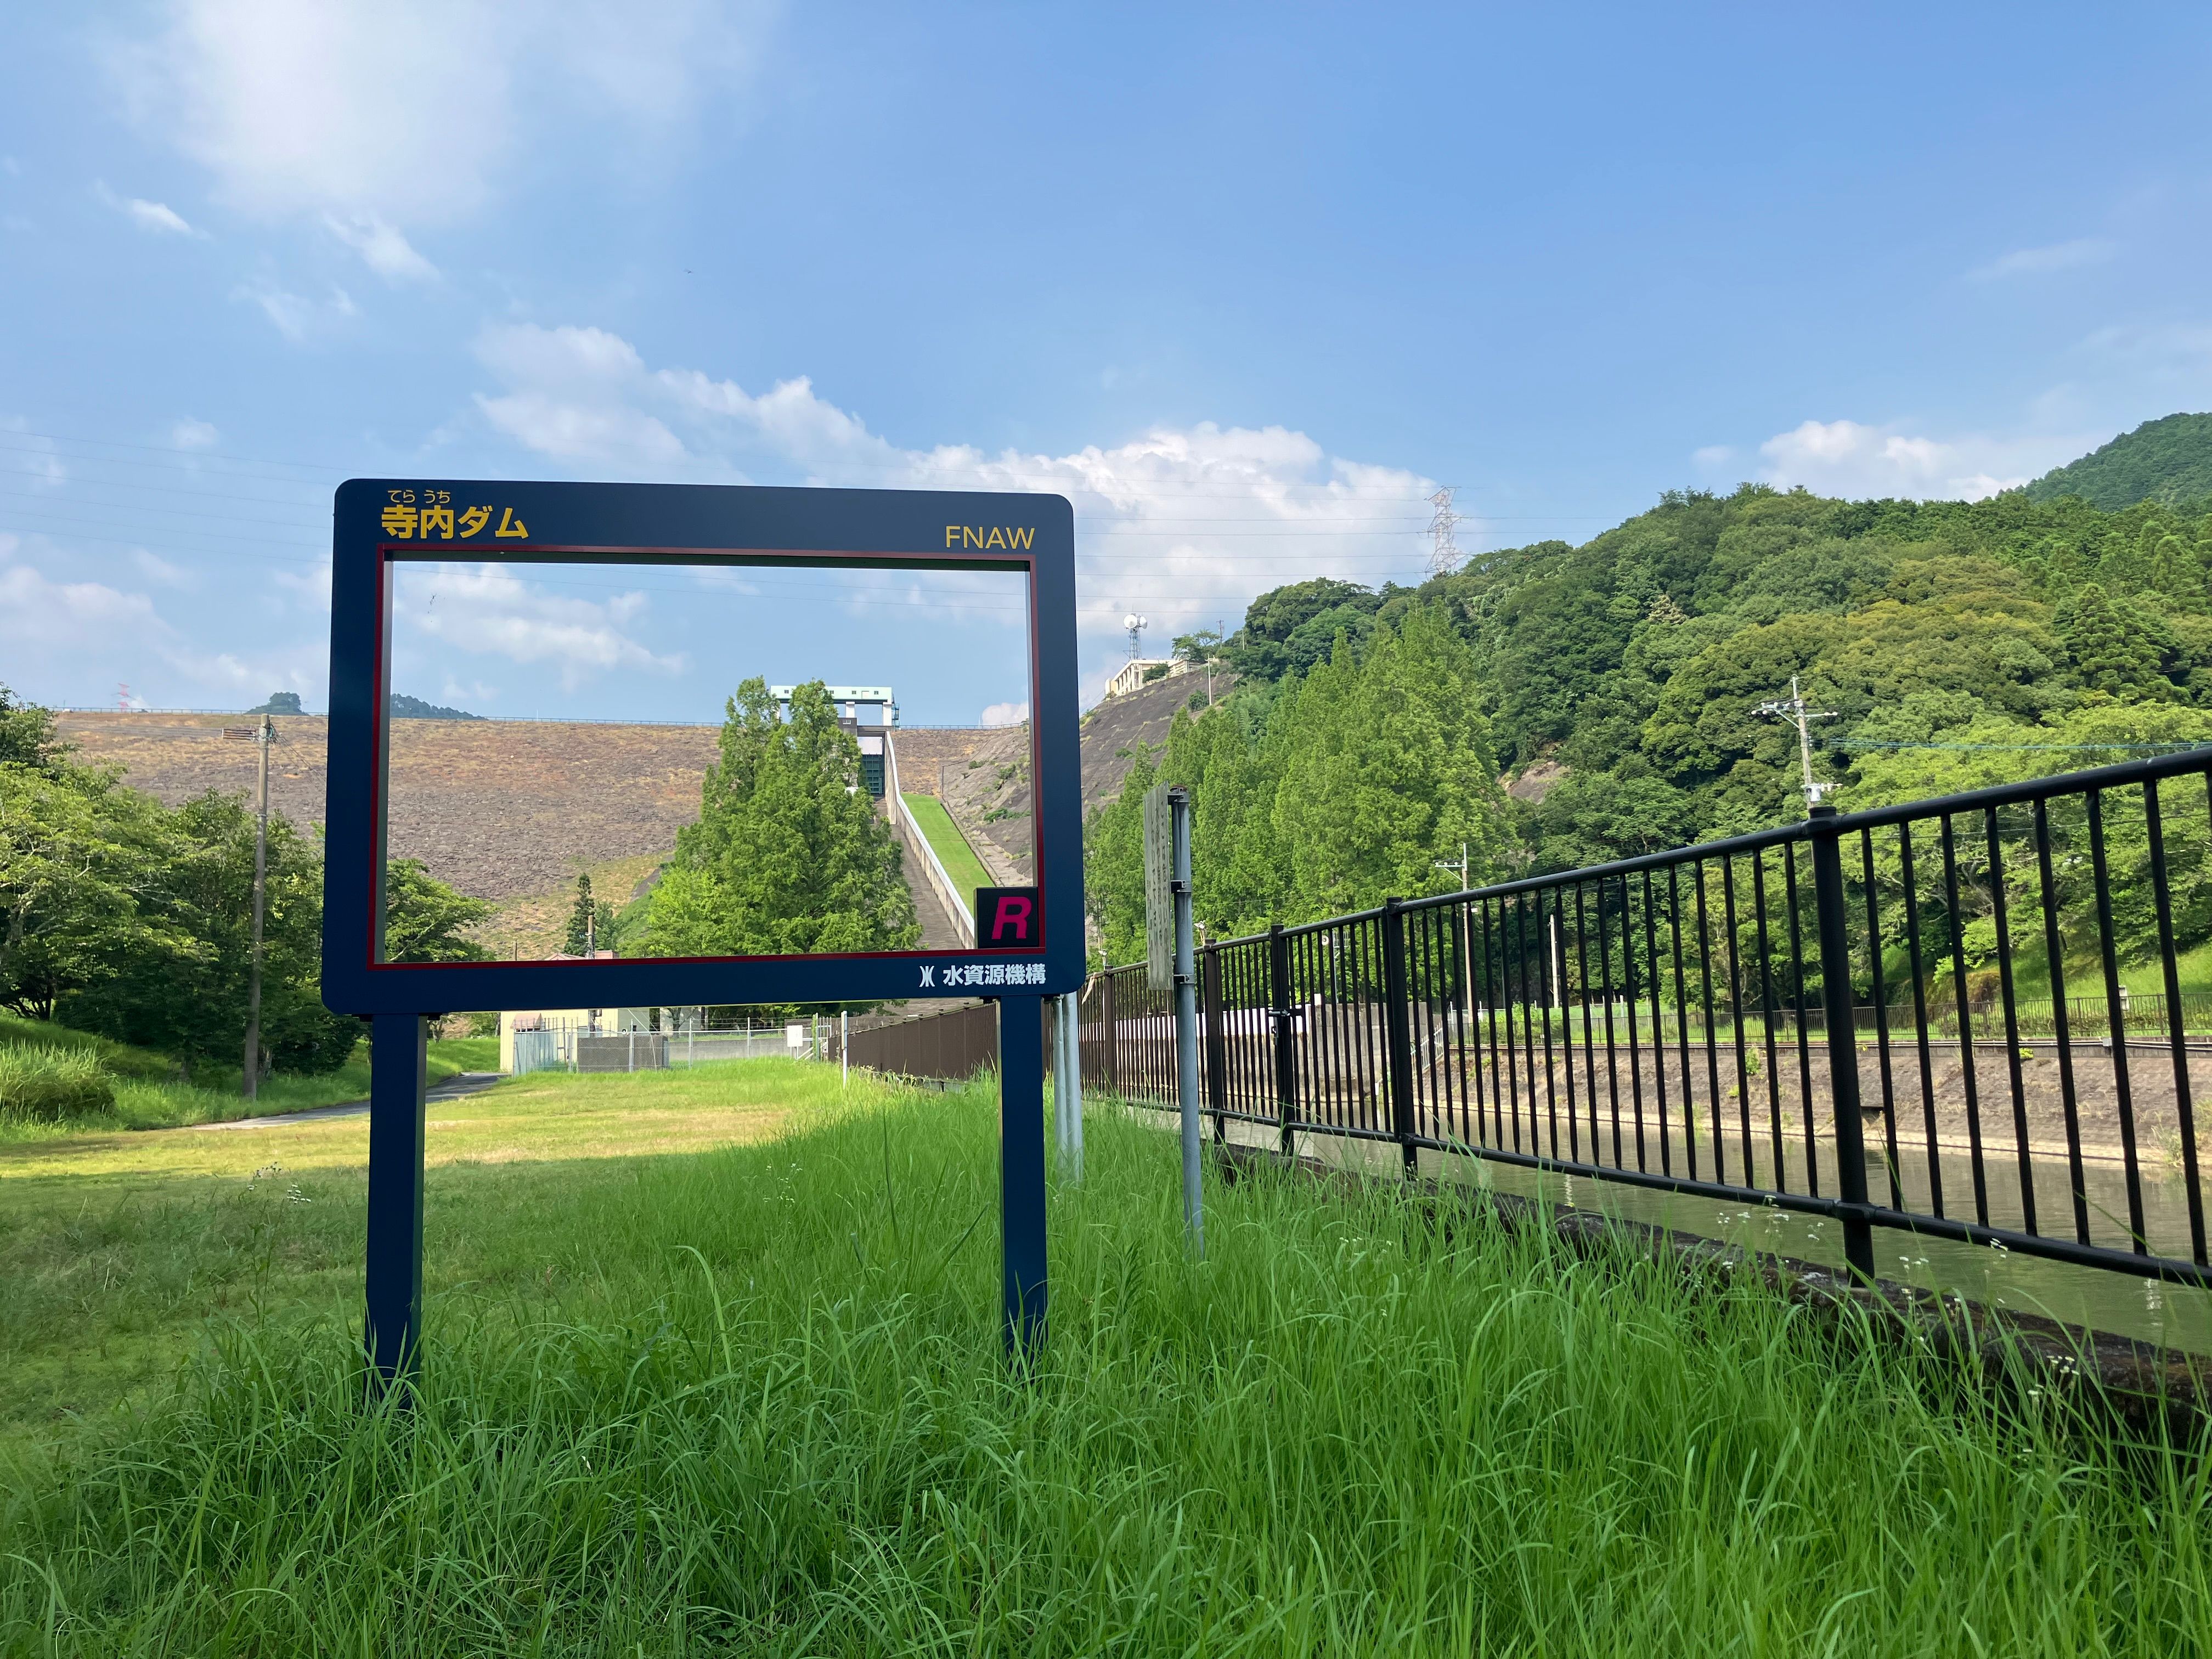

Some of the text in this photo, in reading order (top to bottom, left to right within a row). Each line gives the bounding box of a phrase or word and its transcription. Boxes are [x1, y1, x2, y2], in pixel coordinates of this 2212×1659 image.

[387, 489, 451, 504] てら うち
[381, 504, 529, 539] 寺内ダム
[946, 526, 1035, 550] FNAW
[991, 896, 1032, 940] R
[943, 963, 1046, 986] 水資源機構
